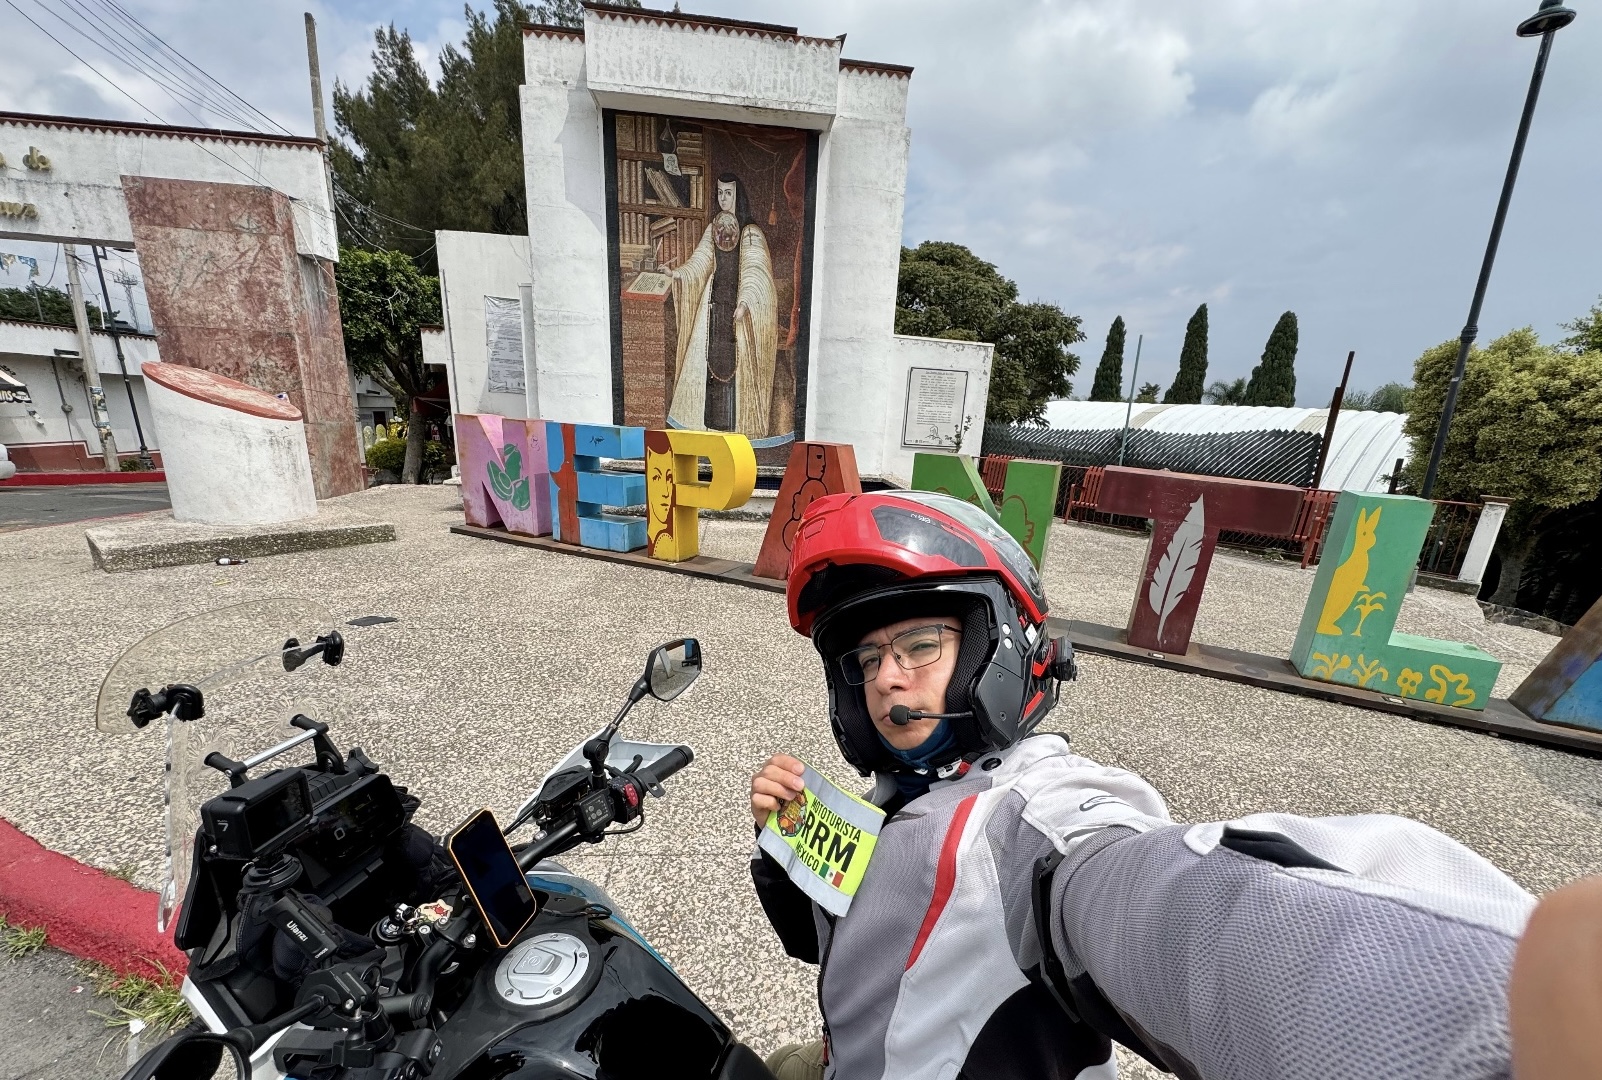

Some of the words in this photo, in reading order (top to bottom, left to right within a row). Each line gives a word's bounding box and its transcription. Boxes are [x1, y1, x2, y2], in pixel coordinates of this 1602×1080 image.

[453, 413, 1602, 732] NEPANTL
[800, 810, 858, 873] RRM
[811, 797, 862, 843] MOTOTURISTA
[286, 920, 308, 942] Ulanzi
